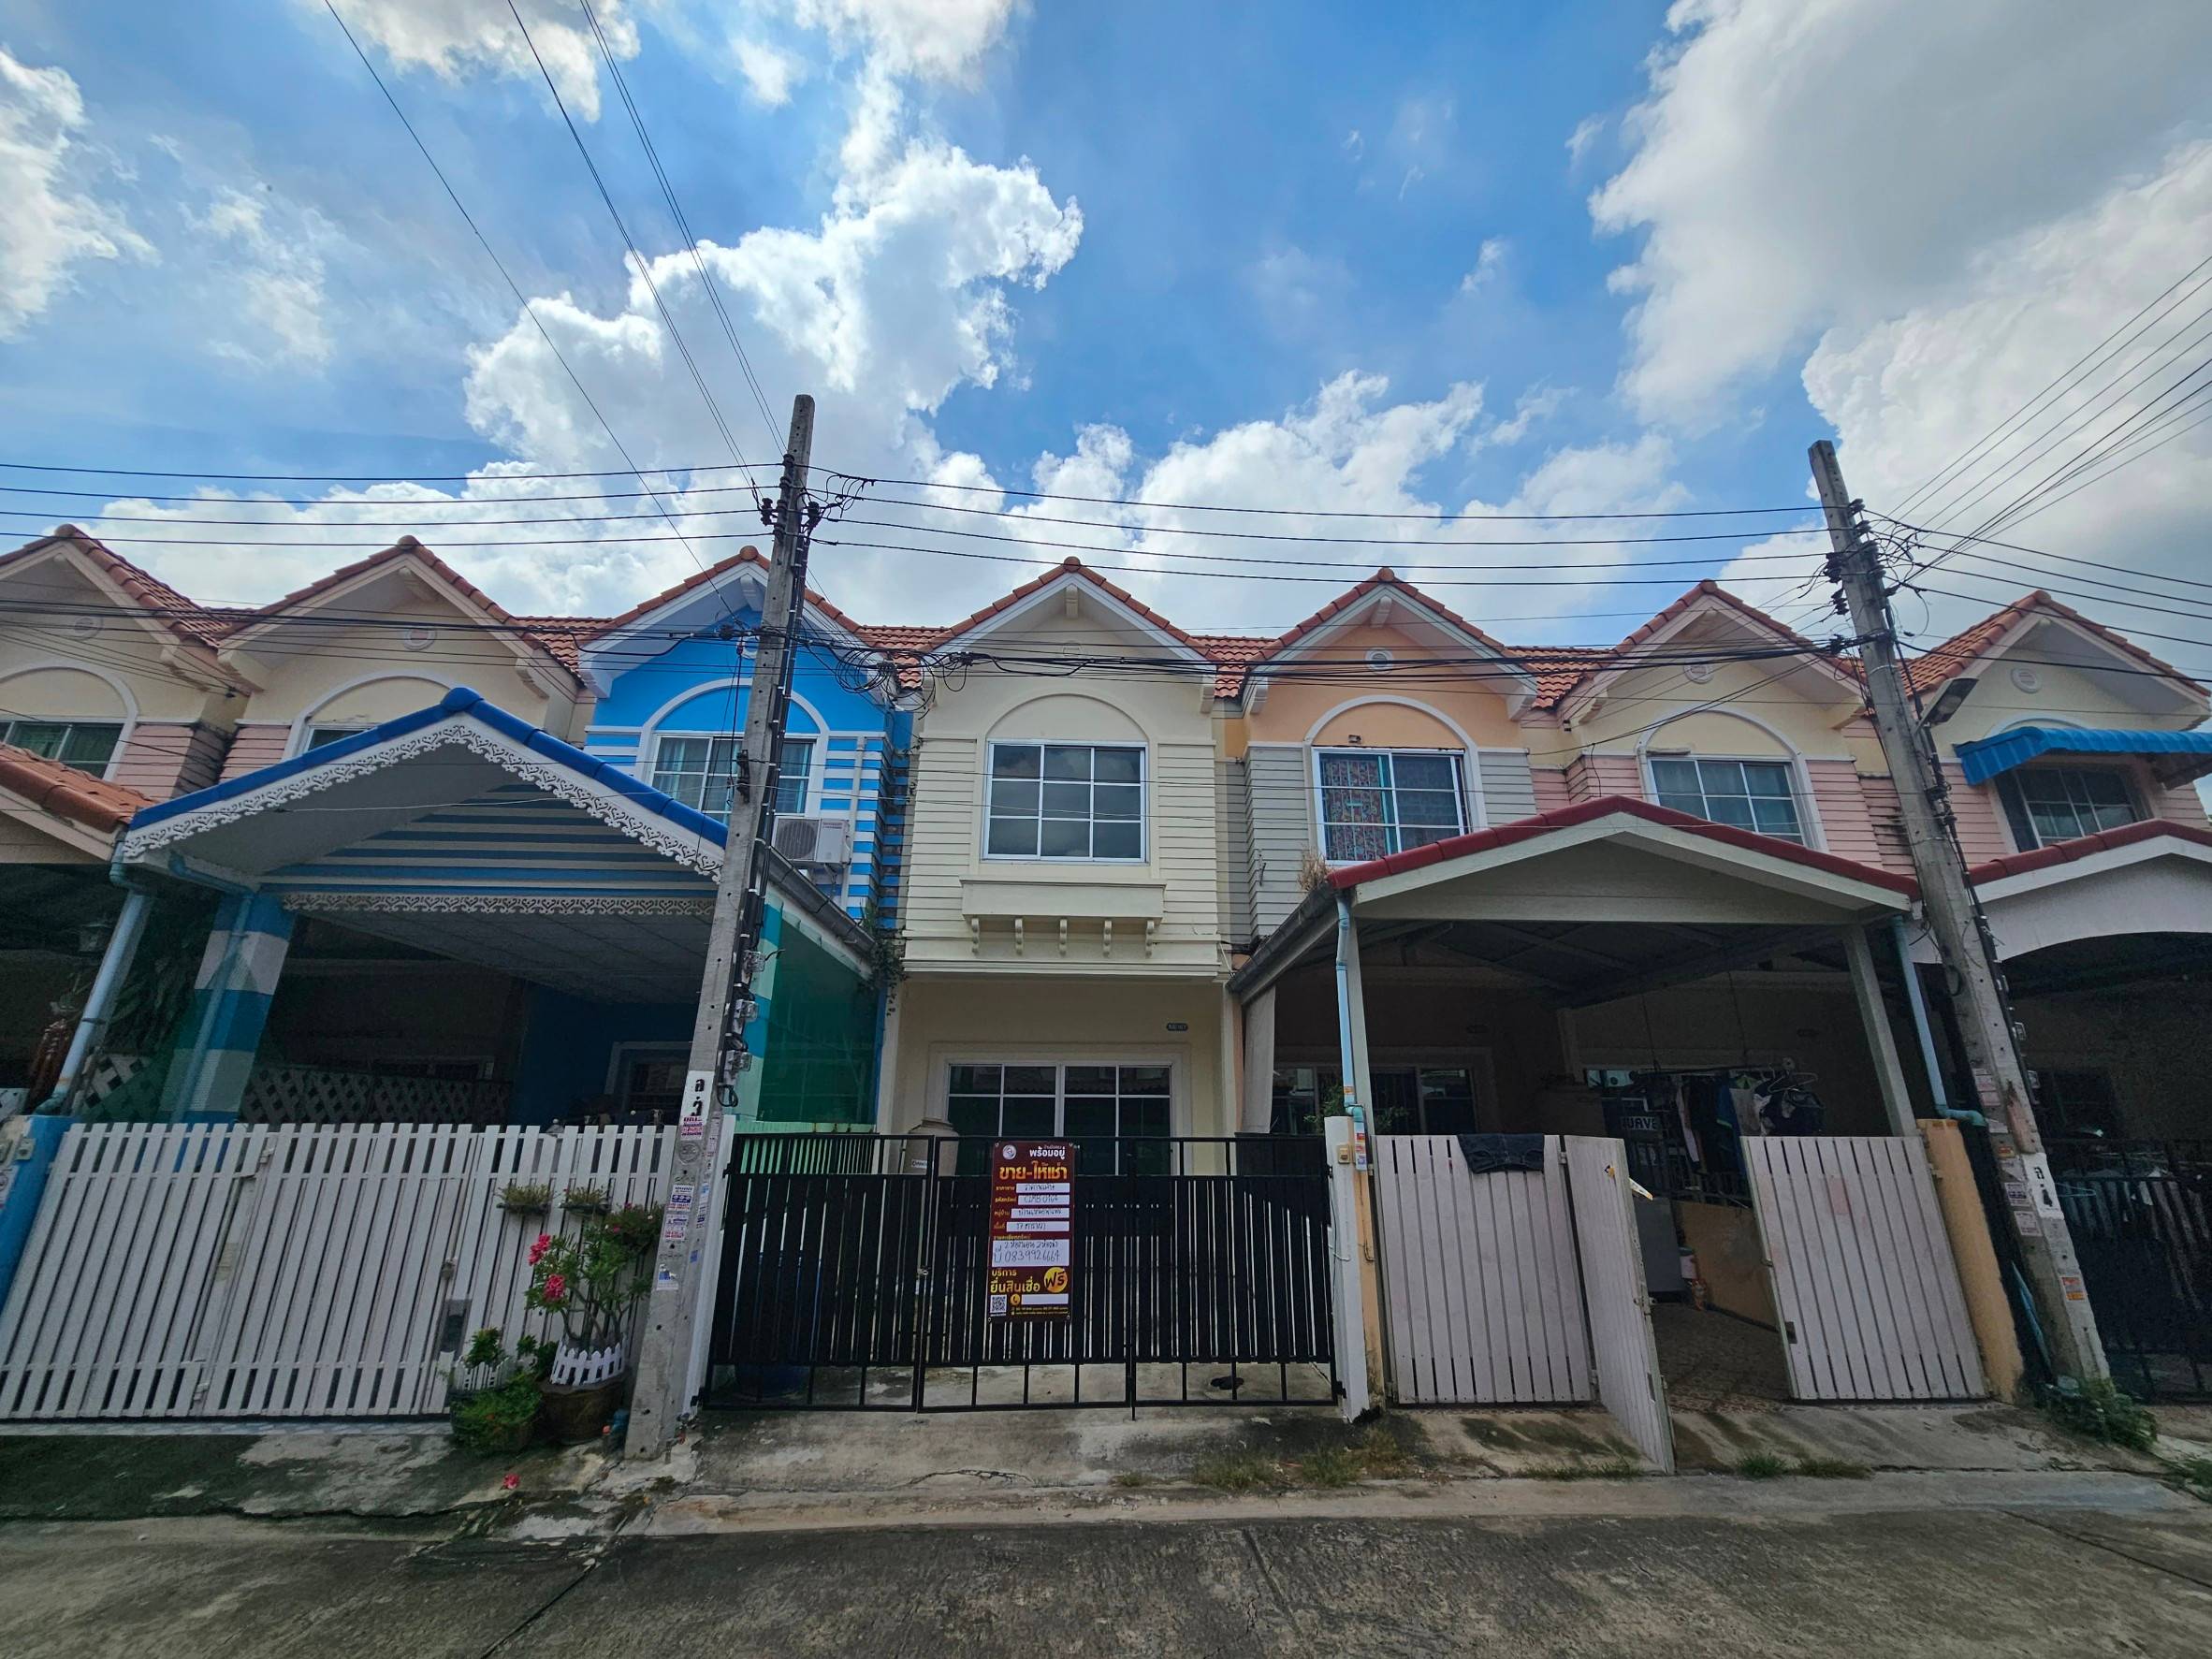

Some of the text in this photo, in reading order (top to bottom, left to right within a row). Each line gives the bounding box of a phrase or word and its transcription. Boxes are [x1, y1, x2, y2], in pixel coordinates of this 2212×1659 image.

[1029, 1145, 1066, 1159] พร้อมอยู่
[999, 1160, 1067, 1179] ขาย-ให้เช่า
[990, 1268, 1065, 1292] ยื่นสินเชื่อ ฟรี
[992, 1268, 1017, 1276] บริการ
